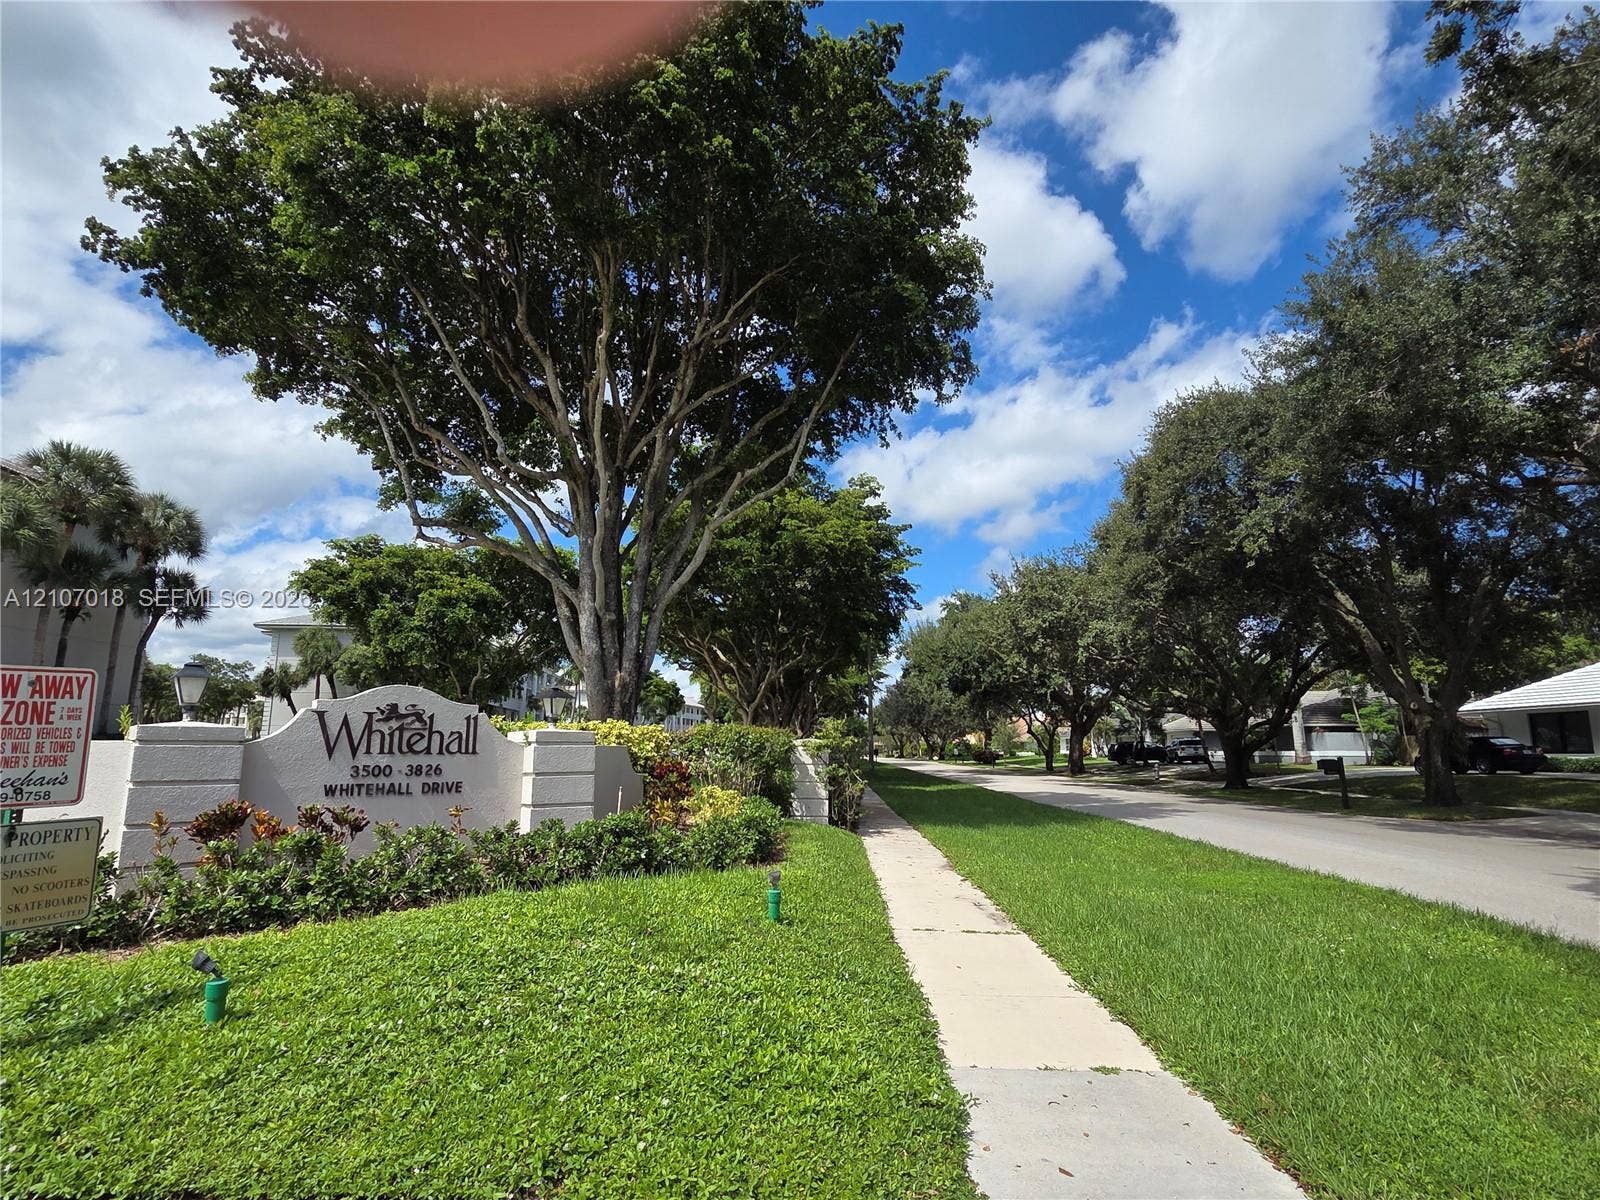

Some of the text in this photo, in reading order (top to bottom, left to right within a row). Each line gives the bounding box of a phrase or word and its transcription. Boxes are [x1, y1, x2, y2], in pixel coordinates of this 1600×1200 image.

[29, 674, 88, 699] AWAY
[0, 700, 56, 725] ZONE
[1, 727, 82, 740] ORIZED VEHICLES &
[311, 711, 479, 761] Whitehall
[11, 742, 30, 754] WILL
[35, 742, 46, 754] BE
[50, 741, 76, 753] TOWED
[33, 755, 68, 768] EXPENSE
[350, 764, 393, 778] 3500
[405, 764, 443, 777] 3826
[0, 769, 69, 788] eehan's
[324, 781, 463, 797] WHITEHALL DRIVE
[5, 827, 94, 848] PROPERTY
[12, 877, 90, 896] NO SCOOTERS
[6, 895, 88, 914] SKATEBOARDS
[22, 909, 85, 924] PROSECUTED
